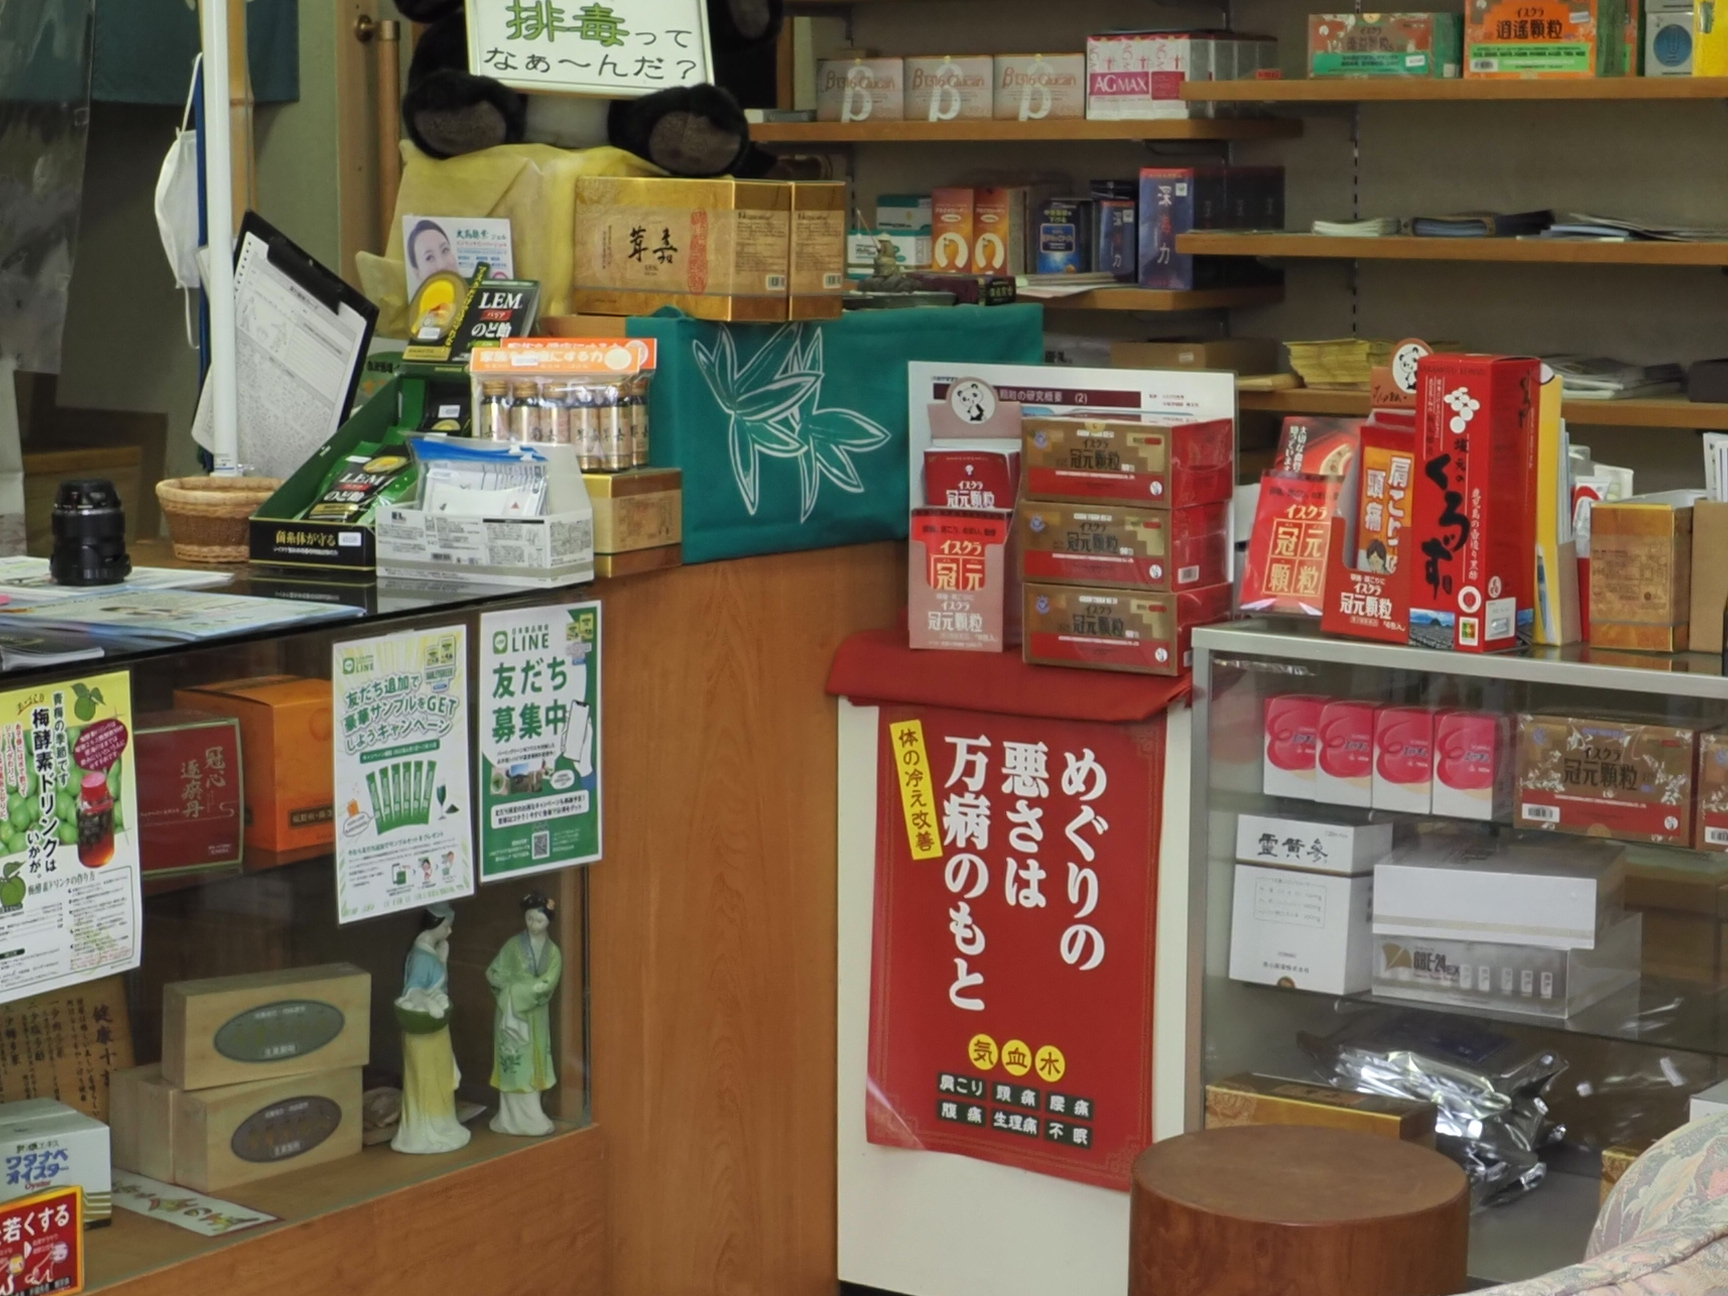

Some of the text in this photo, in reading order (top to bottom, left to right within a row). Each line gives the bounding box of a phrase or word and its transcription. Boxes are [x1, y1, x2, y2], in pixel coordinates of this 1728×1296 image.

[478, 292, 523, 310] LEM
[471, 322, 513, 339] のど飴
[339, 471, 381, 486] LEM
[1273, 523, 1327, 558] 冠元
[1265, 558, 1322, 595] 顆粒
[511, 629, 551, 653] LINE
[491, 655, 569, 700] 友だち
[491, 698, 569, 745] 募集中
[897, 727, 935, 853] 体の冷え改善
[1000, 740, 1051, 910] 悪さは
[942, 734, 992, 1012] 万病のもと
[1059, 747, 1108, 972] めぐりの
[939, 1074, 984, 1096] 肩こり
[993, 1111, 1038, 1136] 生理痛
